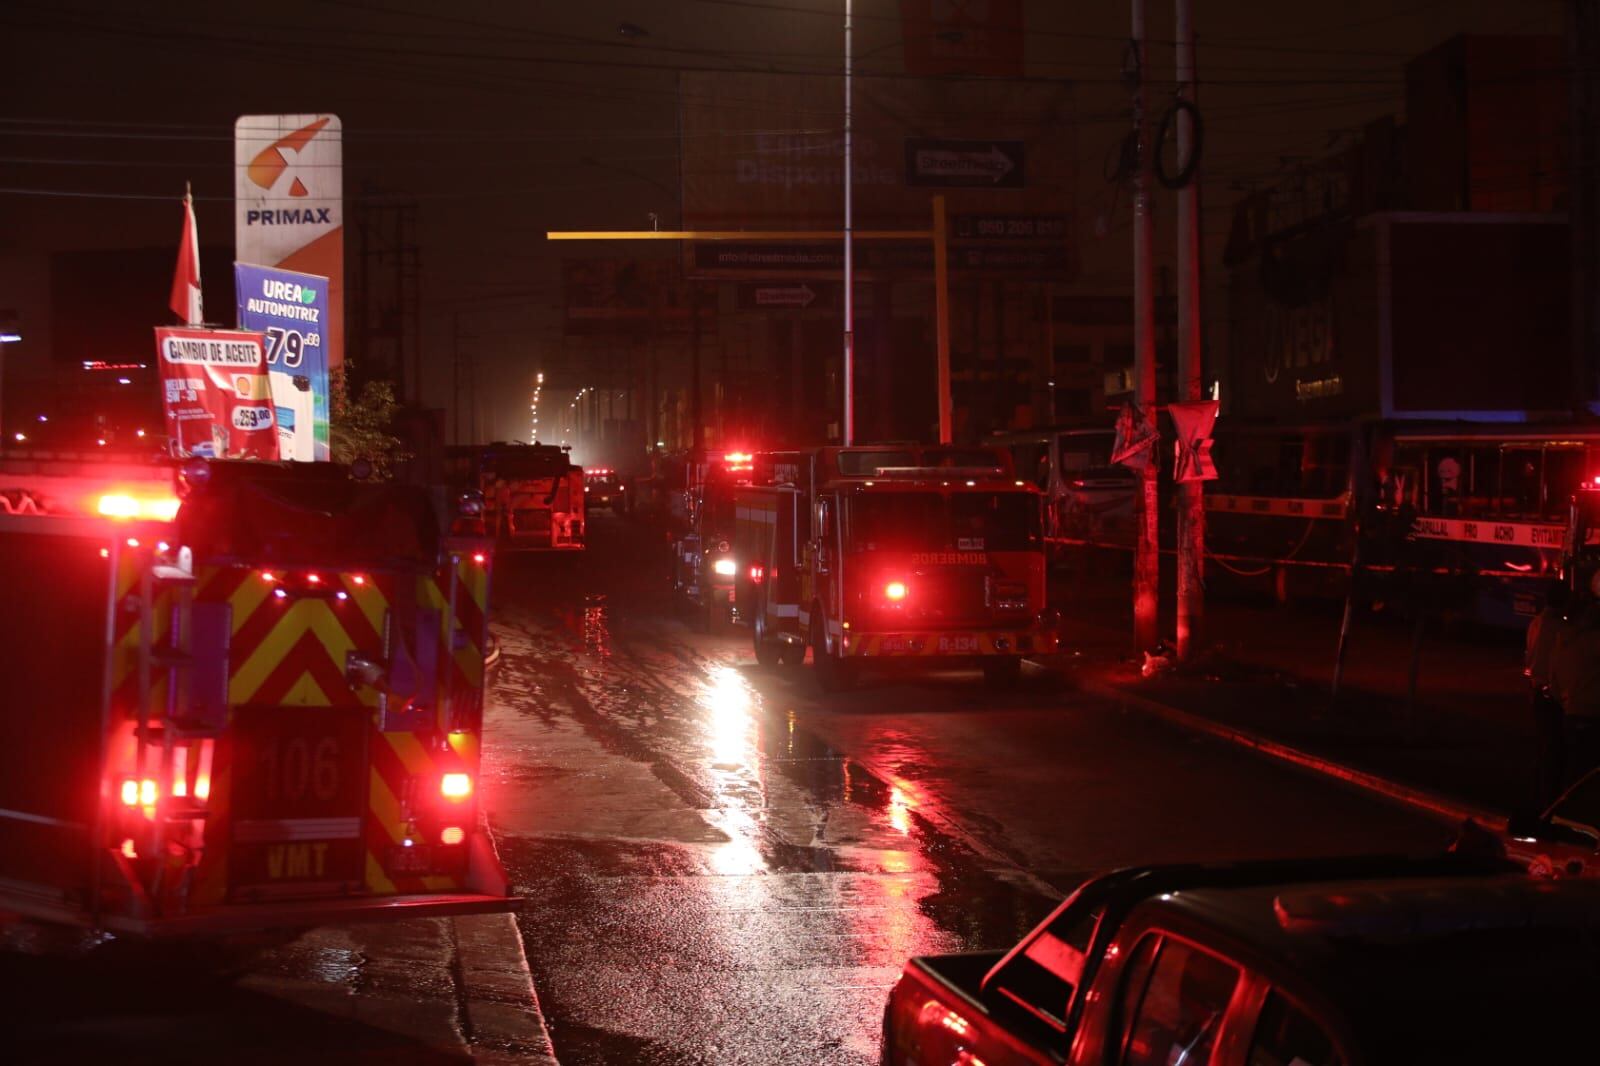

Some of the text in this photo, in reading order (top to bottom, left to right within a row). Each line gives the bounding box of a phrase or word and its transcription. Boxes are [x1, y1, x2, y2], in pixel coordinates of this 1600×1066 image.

[736, 159, 896, 190] Disponble
[247, 208, 331, 225] PRIMAX
[263, 279, 303, 303] UREA
[247, 298, 319, 322] AUTOMOTRIZ
[168, 340, 257, 363] CAMBIO DE ACEITE
[1494, 525, 1514, 541] ACHO
[262, 736, 341, 801] 106
[267, 842, 329, 878] VMT
